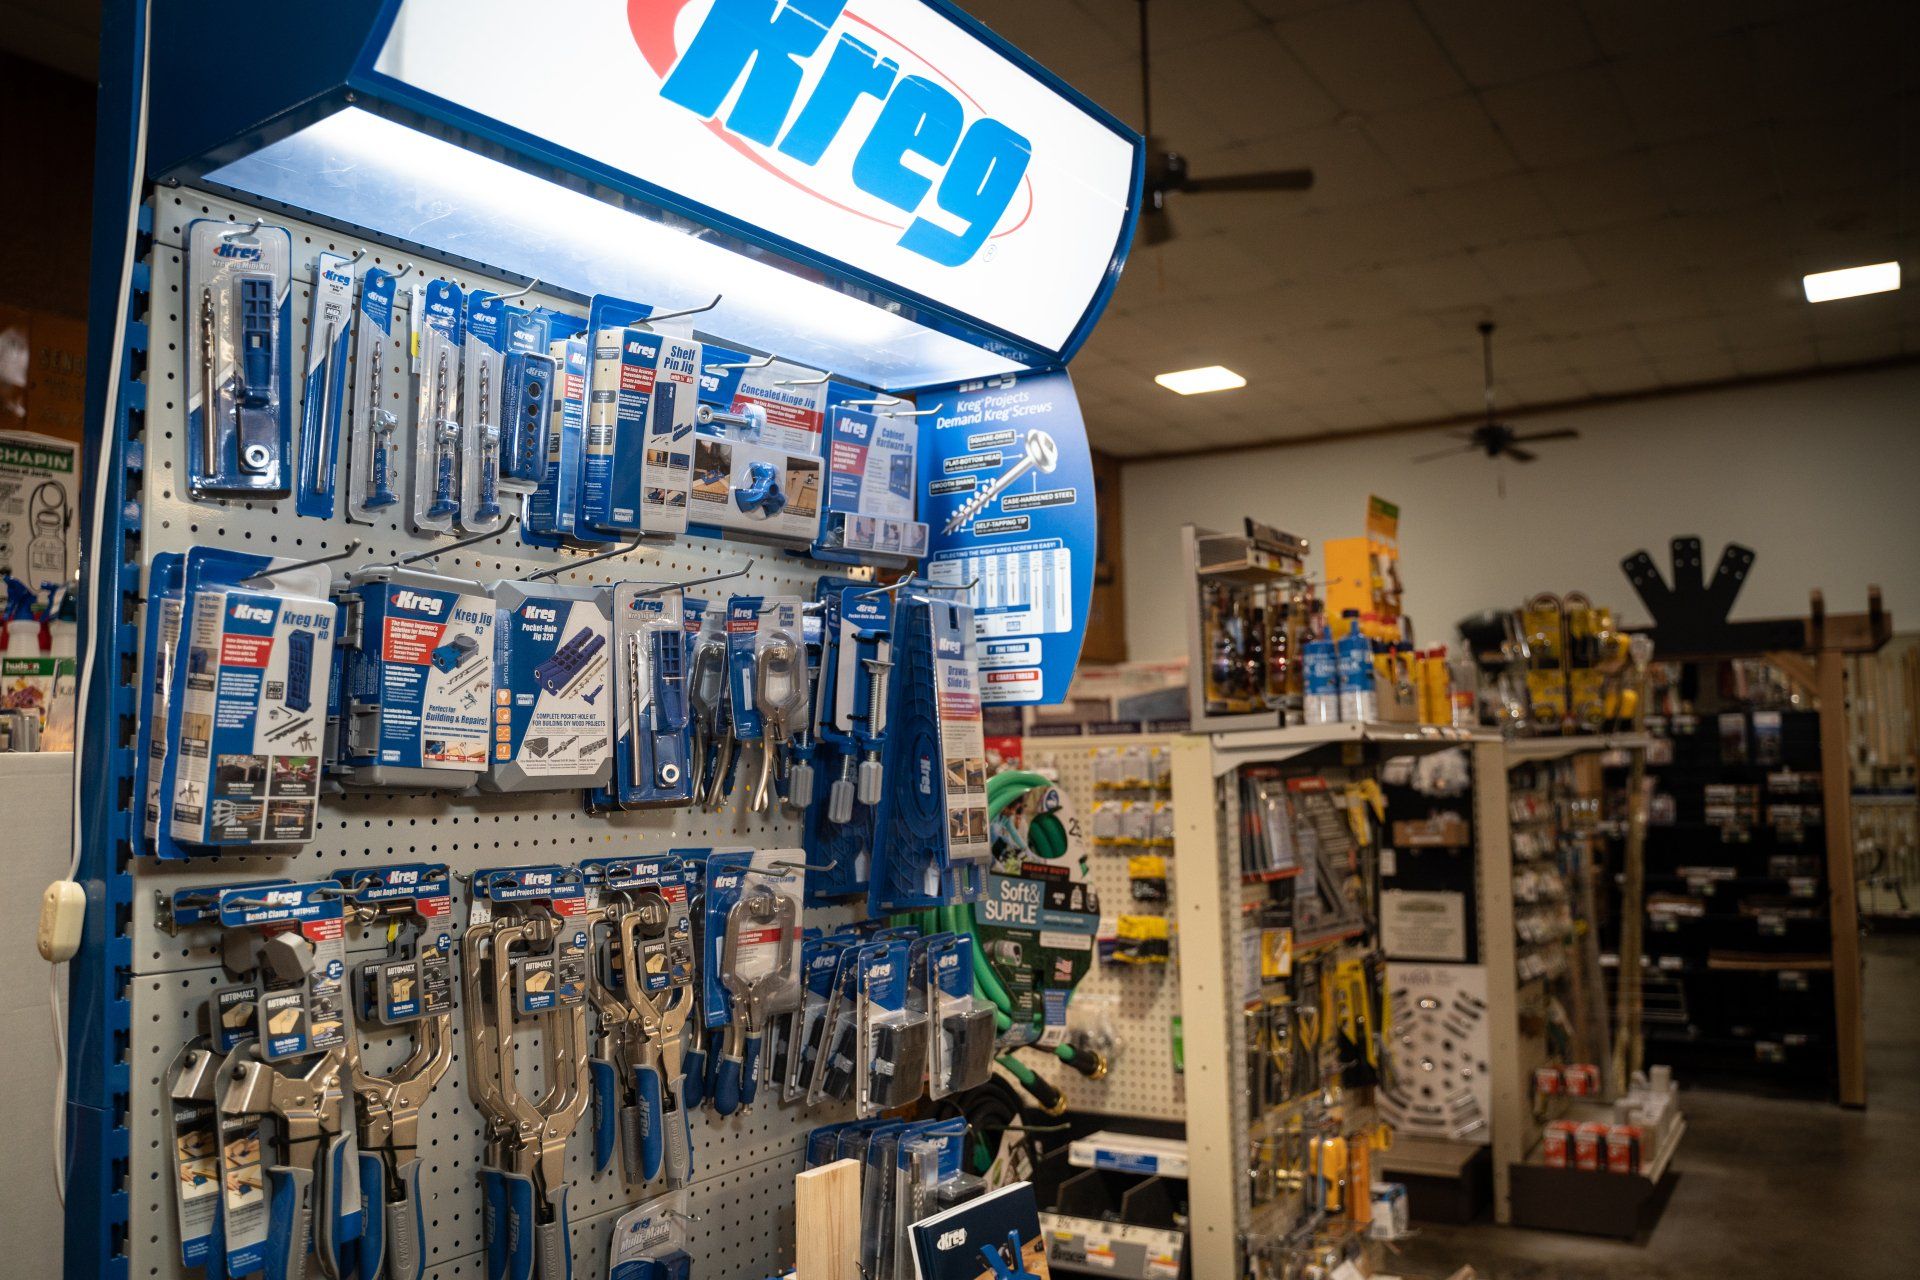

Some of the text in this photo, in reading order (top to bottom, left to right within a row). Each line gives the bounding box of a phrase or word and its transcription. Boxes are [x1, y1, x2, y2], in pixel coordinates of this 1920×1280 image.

[659, 0, 1033, 268] Kreg
[217, 243, 263, 262] Kreg
[325, 270, 350, 286] Kreg
[628, 341, 656, 359] Kreg
[670, 345, 696, 361] Shelf
[527, 366, 549, 379] Kreg
[663, 357, 694, 375] Pin Jig
[741, 383, 816, 409] Concealed Hinge Jig
[984, 392, 1030, 408] Projects
[936, 411, 982, 429] Demand
[1012, 402, 1053, 417] Screws
[840, 417, 868, 438] Kreg
[882, 428, 905, 440] Cabinet
[876, 437, 913, 454] Hardware Jig
[984, 453, 1000, 461] HEAD
[931, 481, 955, 489] SMOOTH
[1003, 491, 1074, 505] CASE-HARDENED STEEL
[976, 517, 1027, 529] SELF-TAPPING TIP
[396, 590, 443, 616] Kreg
[633, 599, 664, 613] Kreg
[860, 604, 878, 614] Kreg
[234, 604, 273, 624] Kreg
[282, 611, 330, 629] Kreg Jig
[454, 608, 493, 626] Kreg Jig
[524, 606, 556, 622] Kreg
[734, 608, 753, 619] Kreg
[475, 626, 484, 635] R3
[521, 623, 558, 632] Pocket-Hole
[318, 631, 329, 640] HD
[532, 632, 554, 641] Jig 320
[938, 637, 961, 654] Kreg
[948, 665, 968, 676] Drawer
[947, 677, 971, 689] Slide Jig
[429, 704, 448, 712] Perfect
[425, 712, 454, 724] Building
[460, 715, 488, 726] Repairs!
[920, 758, 931, 794] Kreg
[636, 863, 659, 876] Kreg
[389, 870, 418, 884] Kreg
[524, 873, 552, 886] Kreg
[715, 876, 737, 888] Kreg
[368, 884, 440, 898] Right Angle Clamp AUTOMAXX
[501, 890, 517, 898] Wood
[517, 889, 535, 897] Project
[535, 887, 552, 896] Clamp
[1000, 881, 1040, 905] Soft&
[267, 891, 302, 906] Kreg
[246, 906, 320, 921] Bench Clamp AUTOMAXX
[985, 900, 1037, 925] SUPPLE
[644, 943, 665, 953] AUTOMAXX
[525, 960, 552, 970] AUTOMAXX
[815, 955, 836, 968] Kreg
[940, 954, 959, 968] Kreg
[387, 964, 415, 976] AUTOMAXX
[870, 964, 891, 978] Kreg
[220, 989, 254, 1003] AUTOMAXX
[267, 995, 300, 1008] AUTOMAXX
[175, 1110, 196, 1122] Clamp
[222, 1118, 243, 1130] Clamp
[620, 1221, 671, 1254] Multi-Mark
[938, 1227, 967, 1251] Kreg
